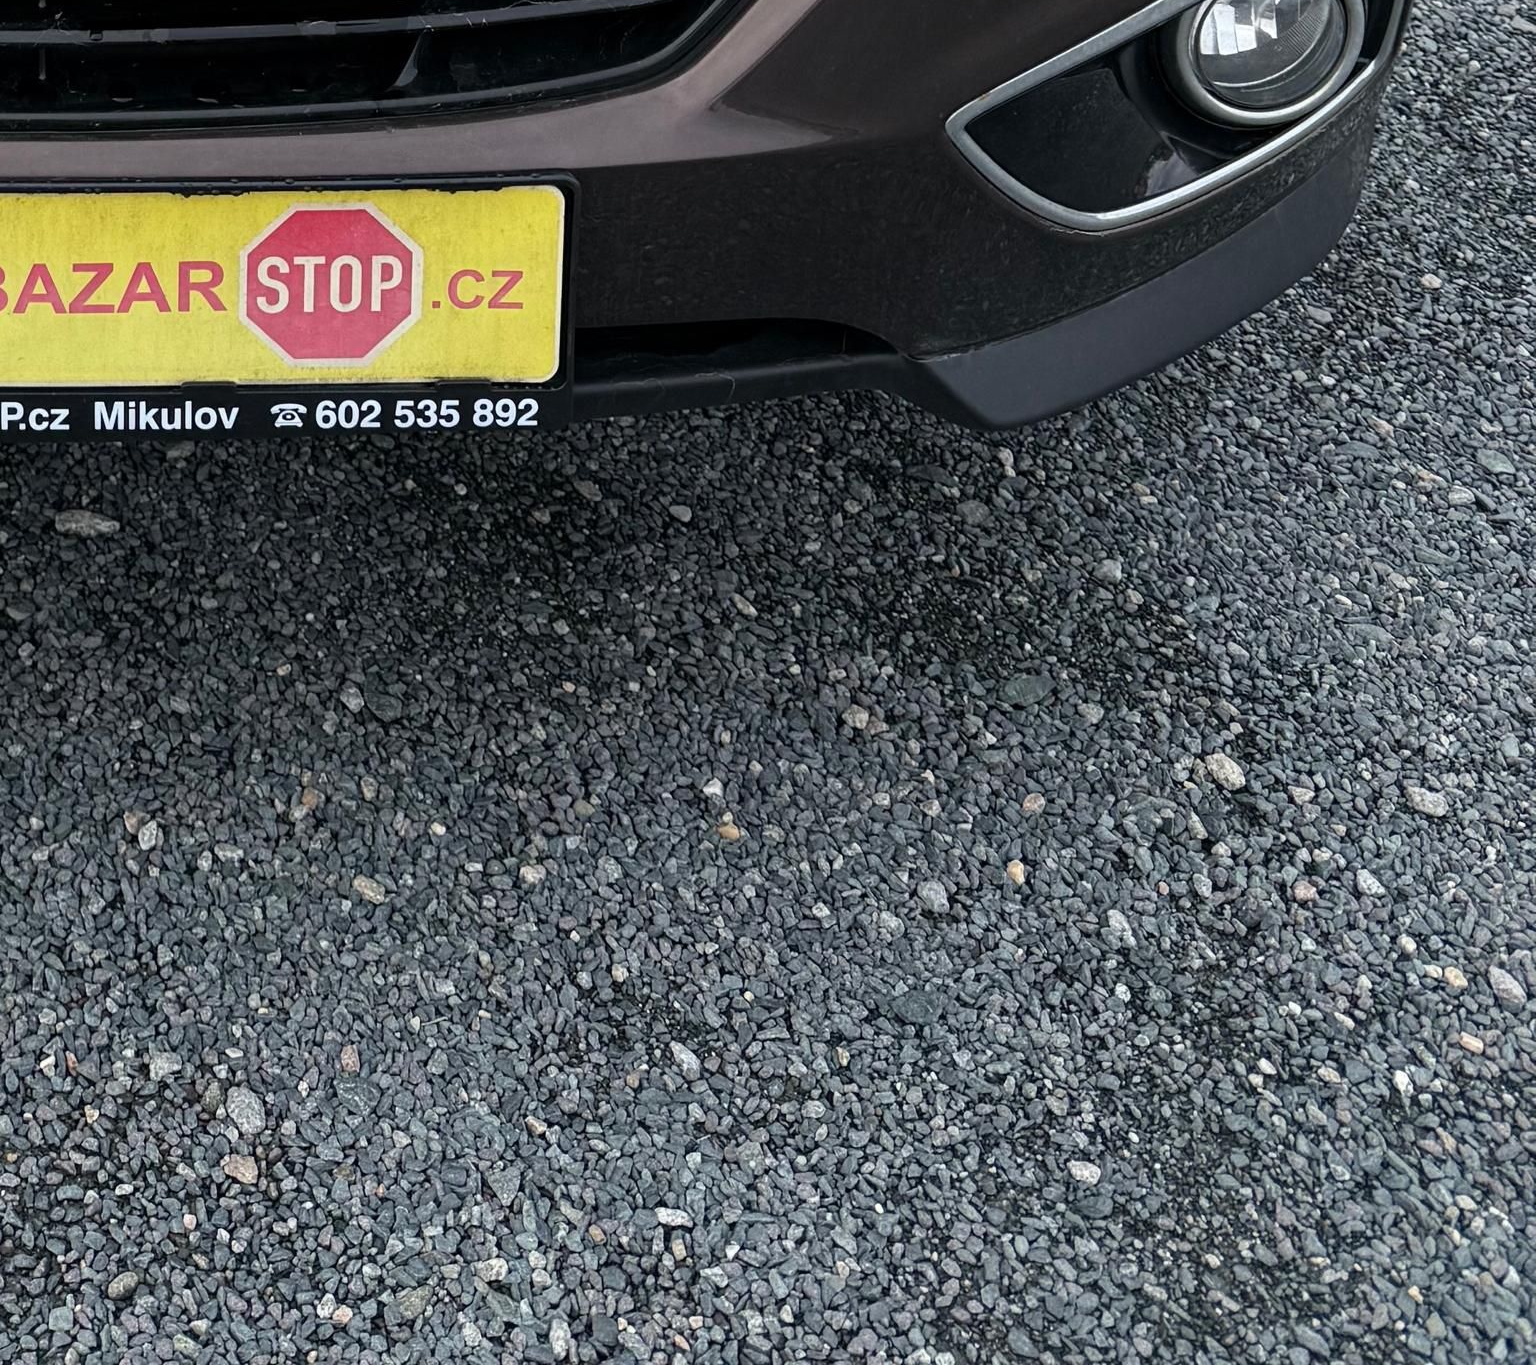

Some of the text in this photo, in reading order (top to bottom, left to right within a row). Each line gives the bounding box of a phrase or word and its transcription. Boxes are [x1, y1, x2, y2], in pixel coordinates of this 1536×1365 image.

[255, 254, 404, 314] STOP
[94, 400, 240, 431] Mikulov
[315, 399, 382, 429] 602
[394, 399, 461, 429] 535
[472, 398, 539, 429] 892
